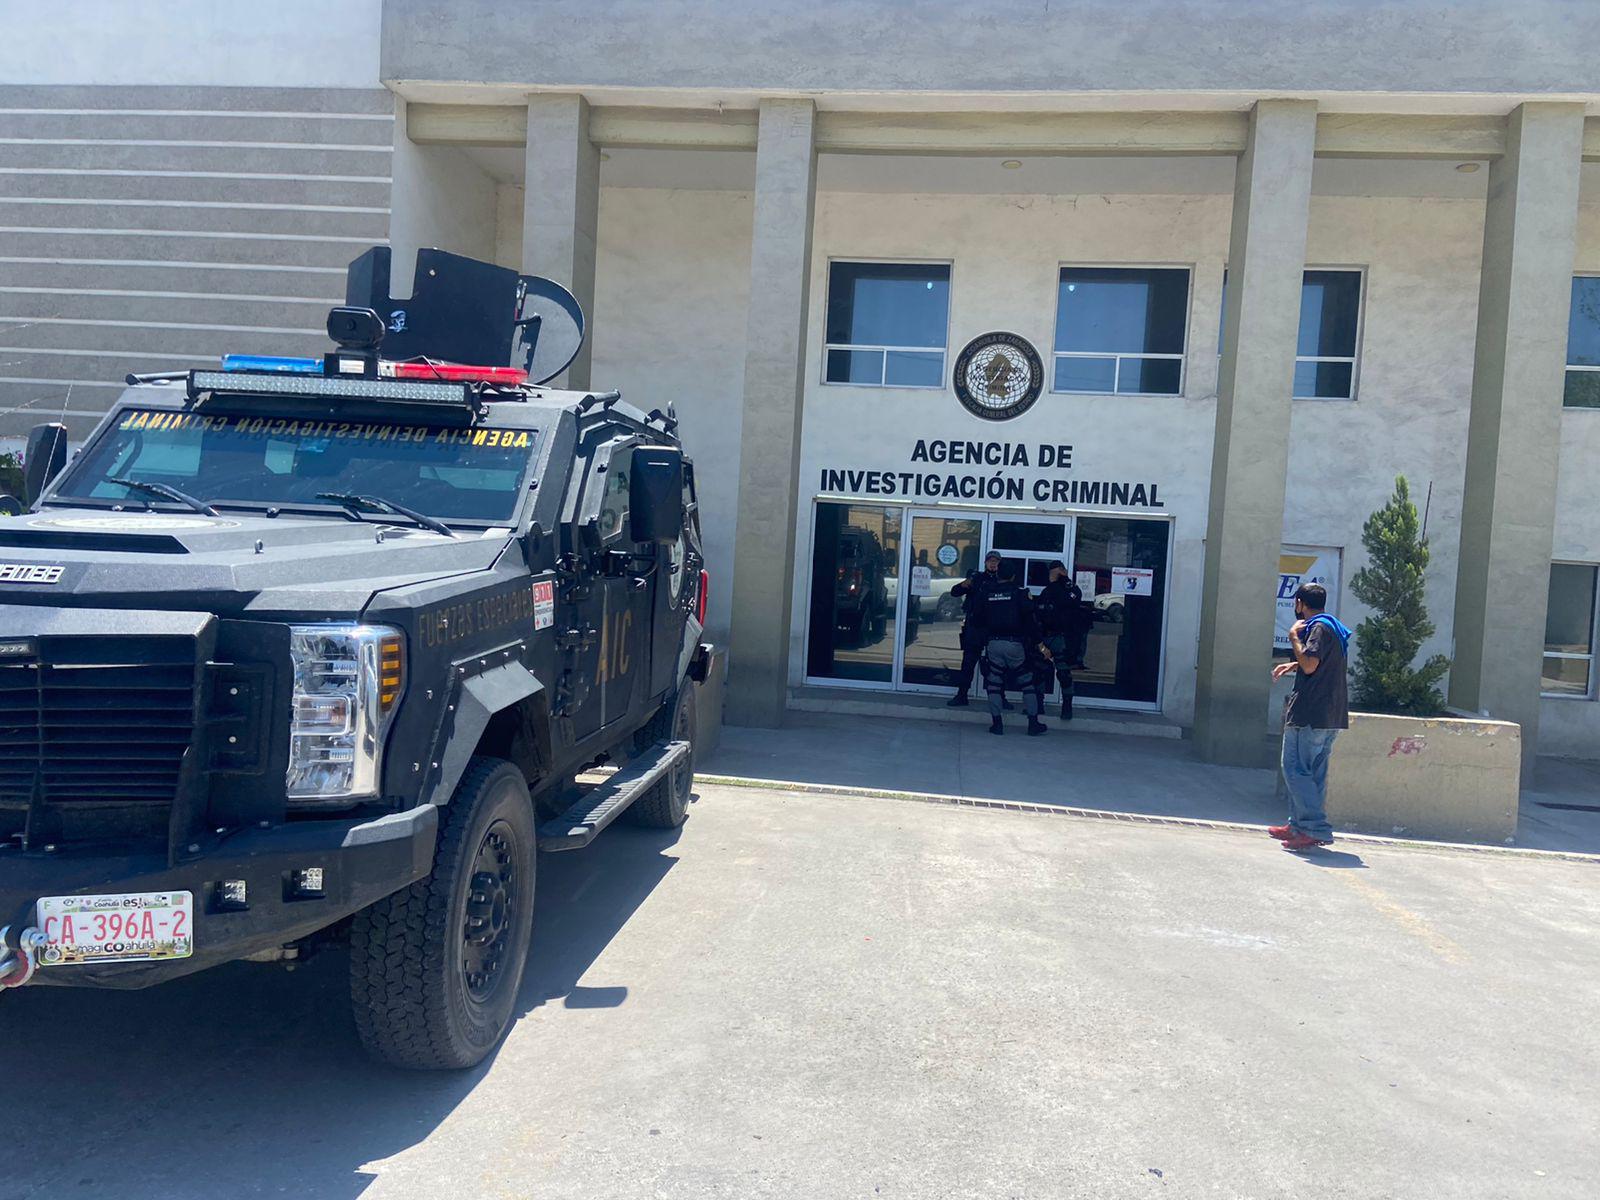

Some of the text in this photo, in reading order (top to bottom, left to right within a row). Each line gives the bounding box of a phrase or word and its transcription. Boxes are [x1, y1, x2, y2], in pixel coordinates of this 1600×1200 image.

[910, 440, 1073, 468] AGENCIA DE
[820, 469, 1164, 507] INVESTIGACIÓN CRIMINAL
[595, 609, 632, 687] AIC
[44, 910, 187, 945] CA-396A-2
